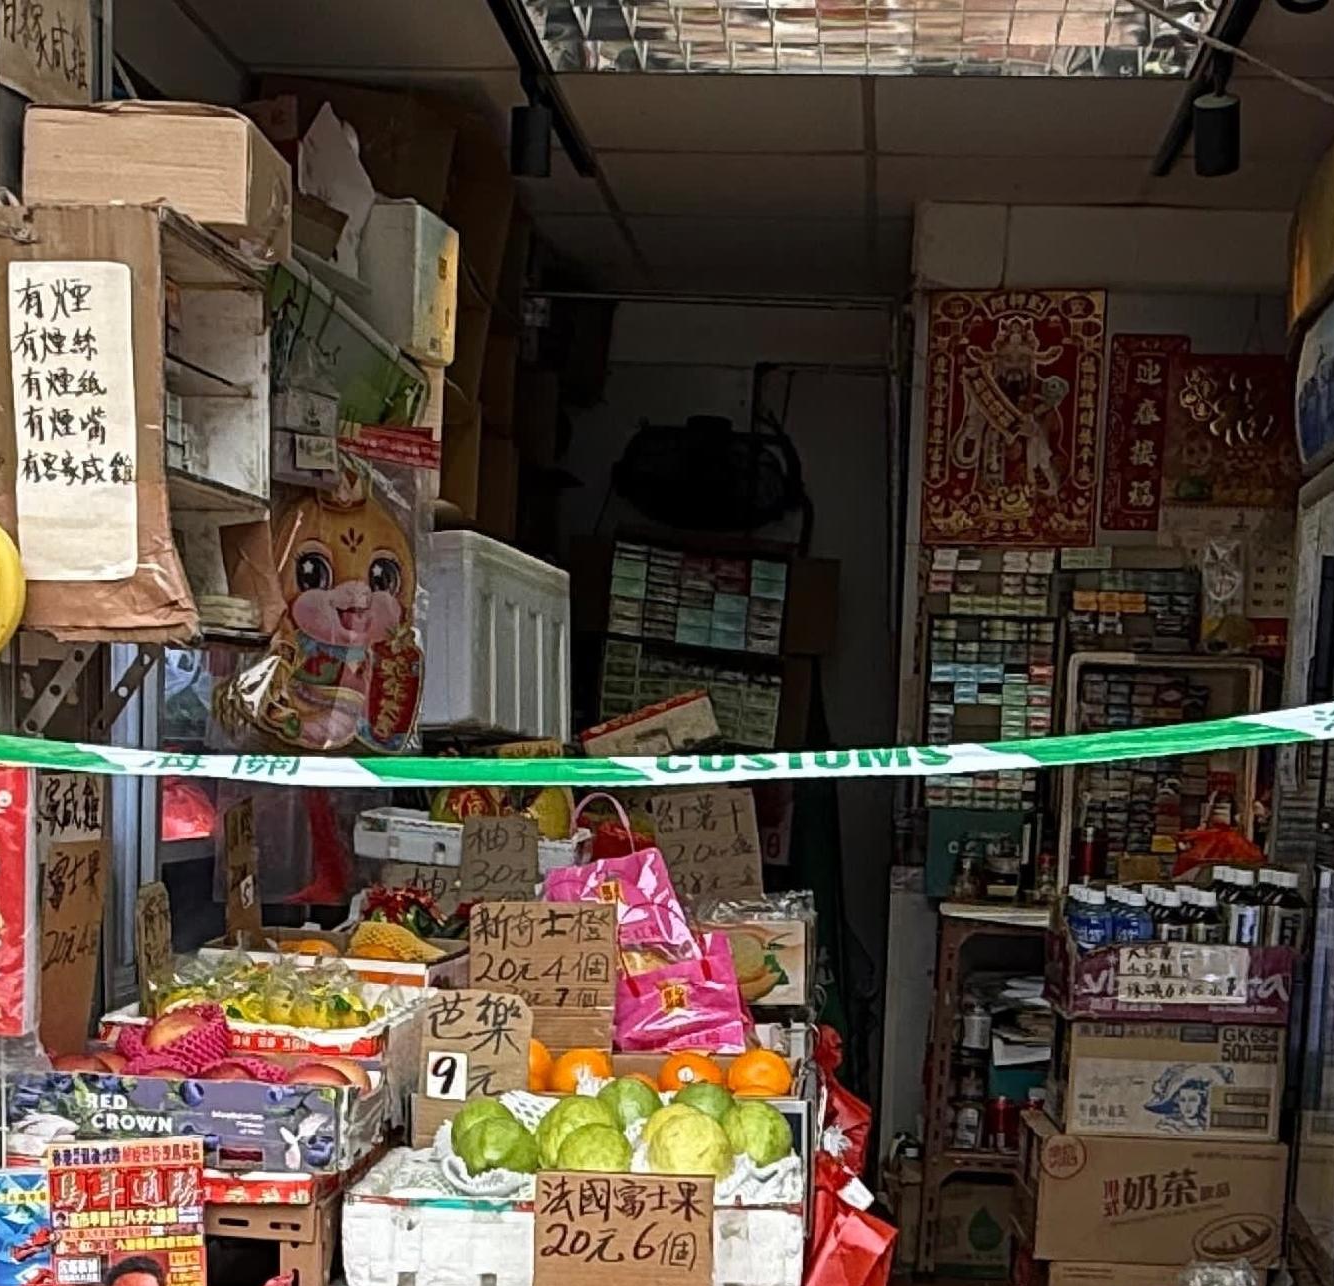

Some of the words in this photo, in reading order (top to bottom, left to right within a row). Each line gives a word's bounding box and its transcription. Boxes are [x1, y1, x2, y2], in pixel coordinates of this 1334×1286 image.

[16, 278, 92, 320] 有煙
[655, 746, 955, 776] CUSTOMS
[470, 822, 534, 854] 柚子
[475, 951, 611, 985] 20元4個
[426, 988, 522, 1056] 芭樂
[431, 1055, 457, 1097] 9
[465, 1063, 505, 1098] 元
[86, 1092, 129, 1110] RED
[91, 1113, 173, 1133] CROWN
[538, 1179, 708, 1222] 法國富士果
[539, 1222, 698, 1271] 20元6個
